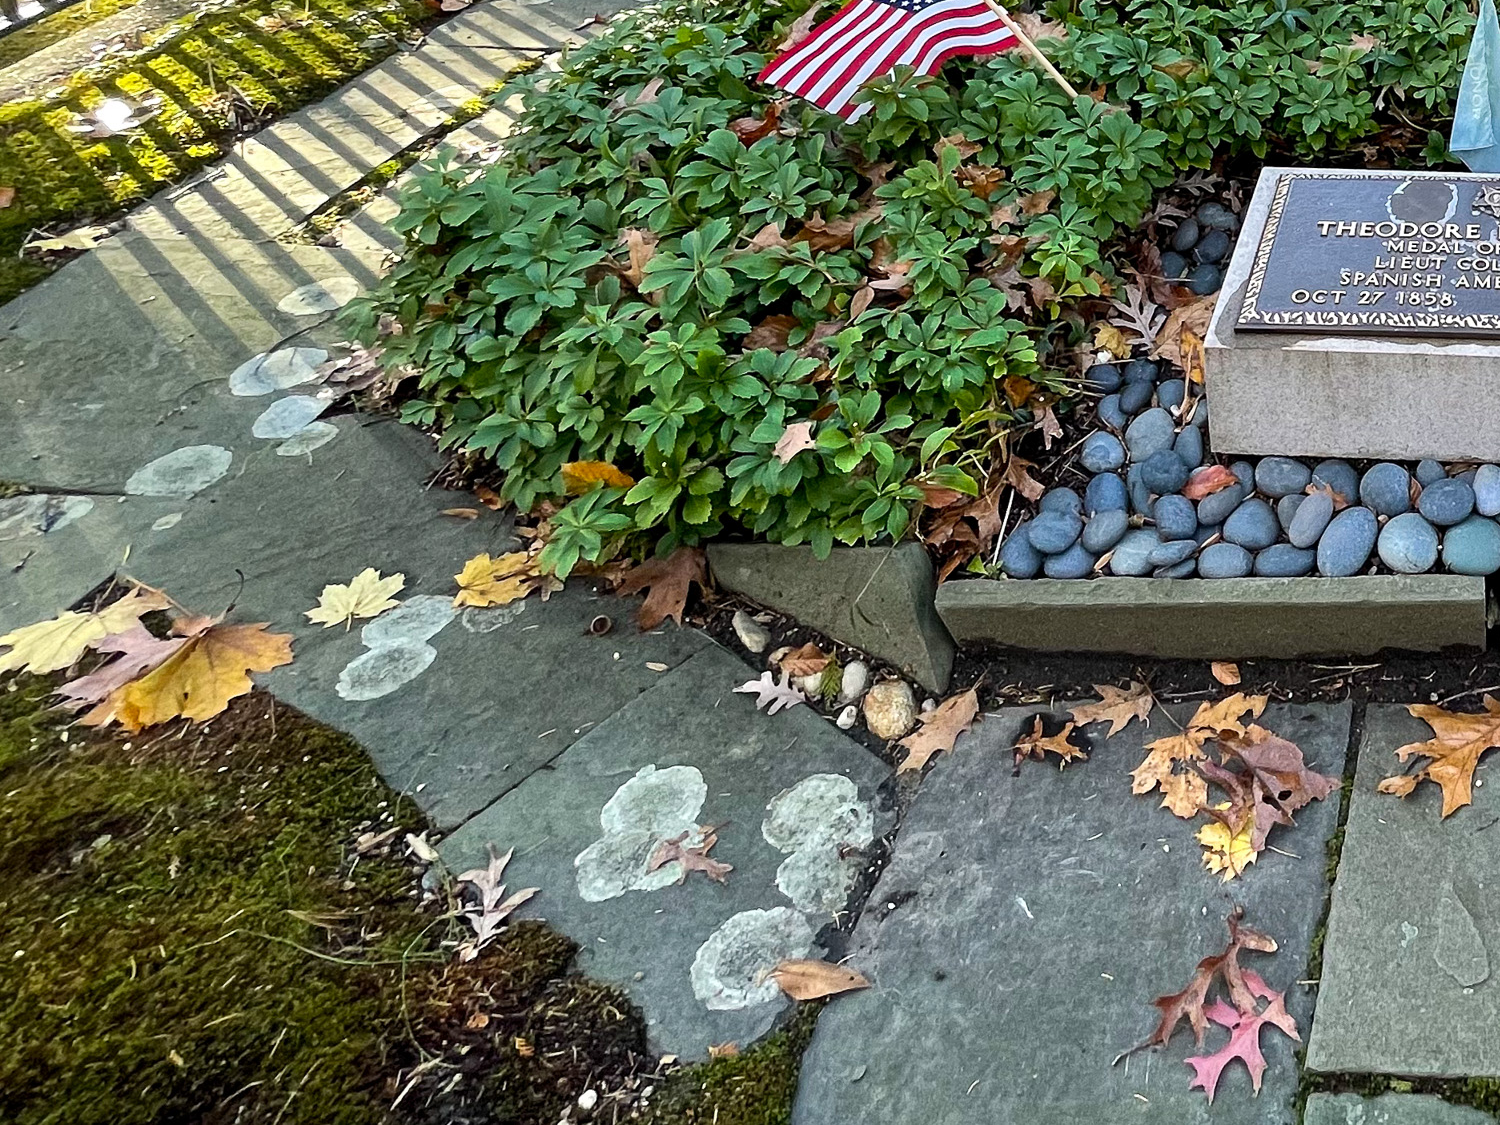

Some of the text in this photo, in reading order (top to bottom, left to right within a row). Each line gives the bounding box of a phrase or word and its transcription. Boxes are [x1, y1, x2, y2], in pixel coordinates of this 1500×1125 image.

[1317, 220, 1482, 239] THEODORE
[1387, 240, 1467, 254] MEDAL
[1374, 255, 1447, 270] LIEUT
[1339, 272, 1443, 288] SPANISH
[1291, 289, 1347, 305] OCT
[1357, 290, 1386, 306] 27
[1398, 291, 1454, 307] 1858
